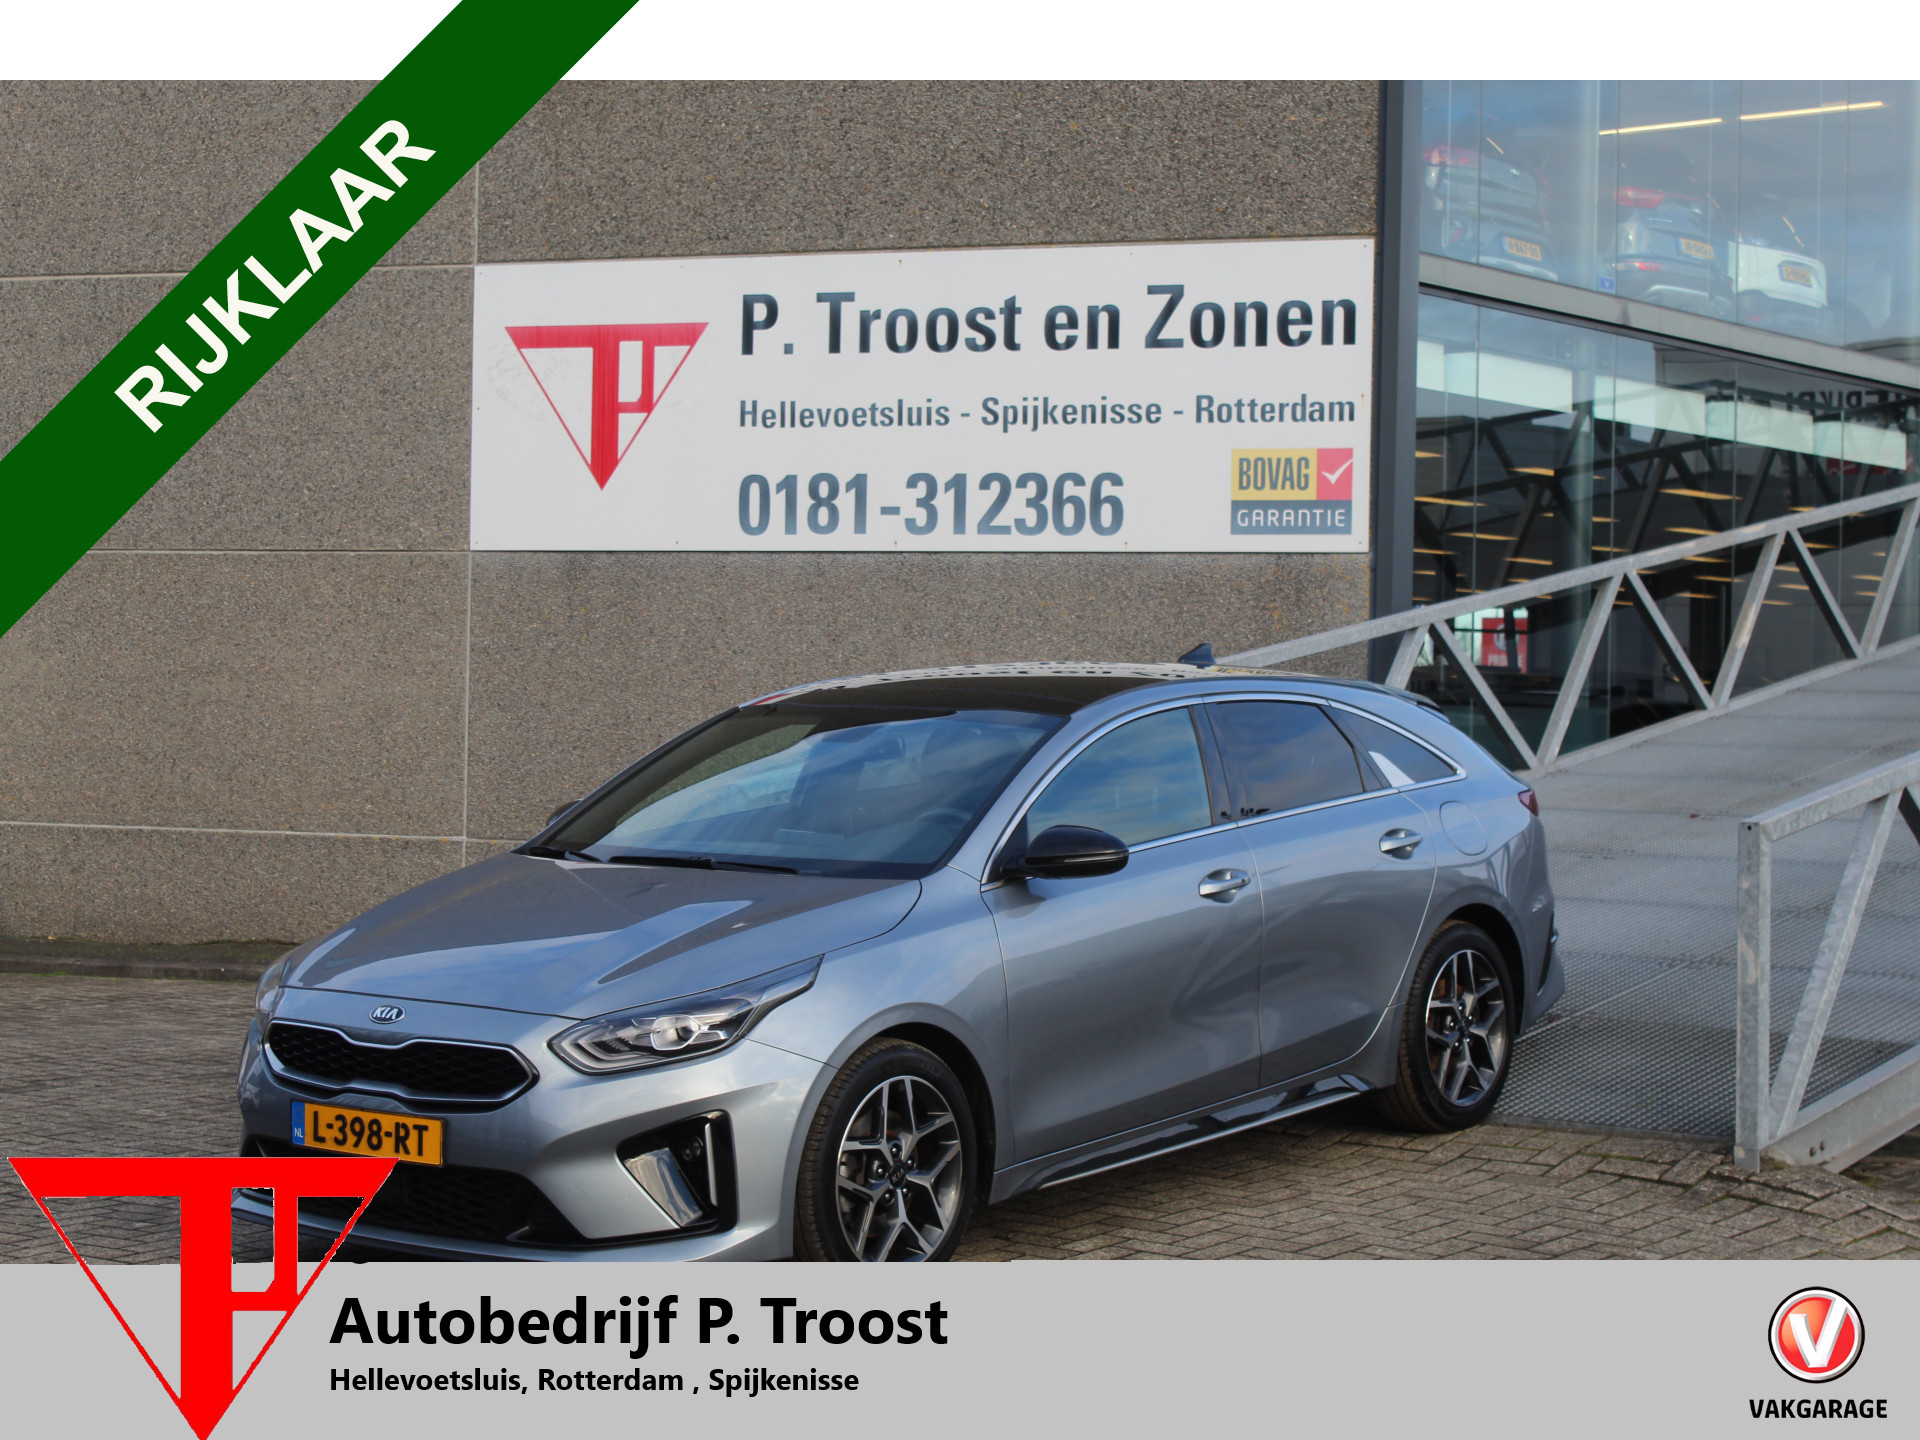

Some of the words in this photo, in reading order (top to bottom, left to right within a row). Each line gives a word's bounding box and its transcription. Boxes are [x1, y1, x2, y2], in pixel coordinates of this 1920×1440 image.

[741, 293, 794, 356] P.
[816, 291, 1022, 354] Troost
[1043, 304, 1121, 352] en
[1144, 284, 1357, 349] Zonen
[739, 398, 950, 429] Hellevoetsluis
[981, 395, 1162, 434] Spijkenisse
[1195, 393, 1355, 424] Rotterdam
[1238, 456, 1310, 491] BOVAG
[738, 472, 1124, 537] 0181-312366
[1237, 509, 1346, 527] GARANTIE
[373, 1006, 399, 1020] KIA
[294, 1127, 304, 1138] NL
[313, 1110, 429, 1157] L-398-RT
